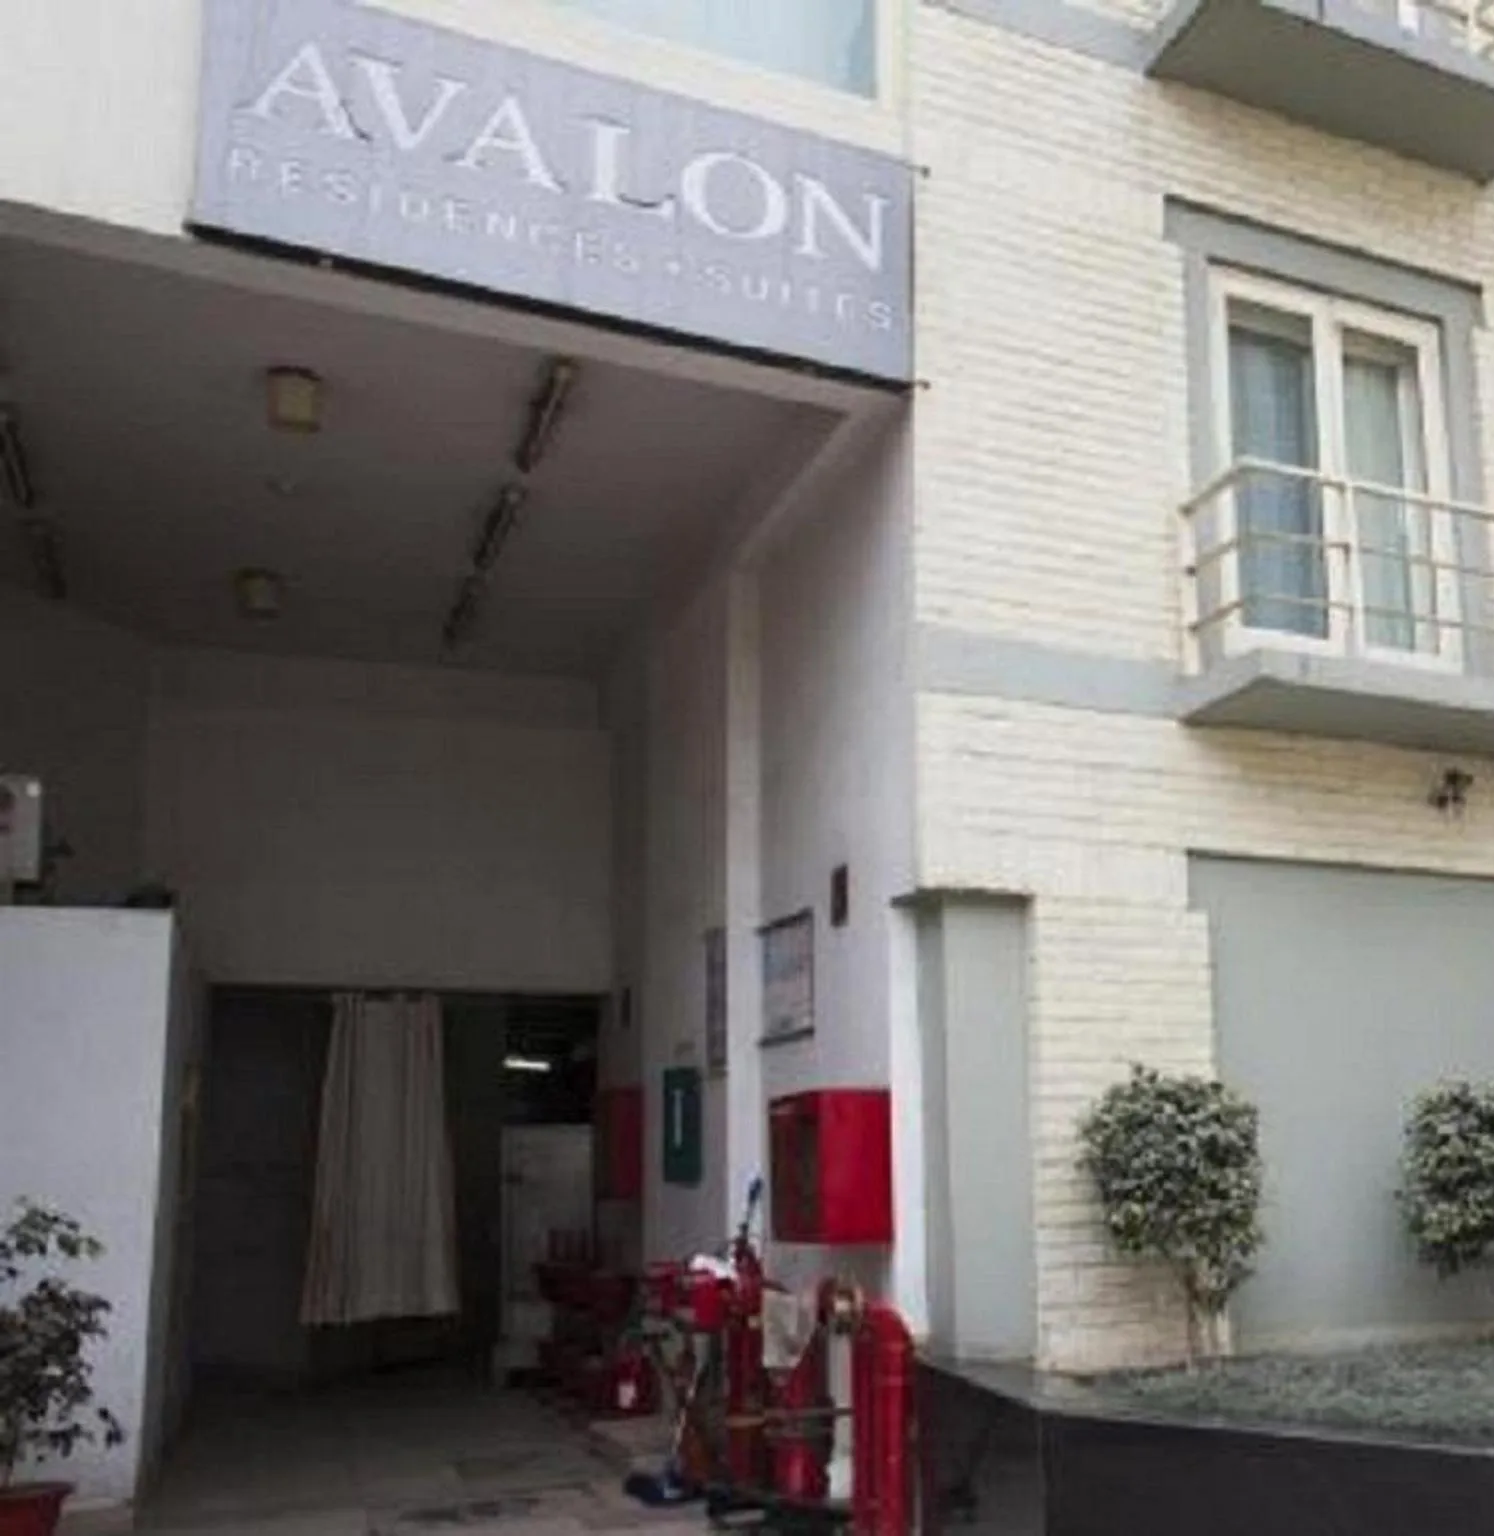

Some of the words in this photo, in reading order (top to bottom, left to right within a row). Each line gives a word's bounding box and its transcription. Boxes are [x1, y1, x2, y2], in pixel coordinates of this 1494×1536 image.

[227, 147, 641, 274] RESIDENCES
[703, 263, 893, 331] SUITES
[234, 42, 891, 271] AVALON
